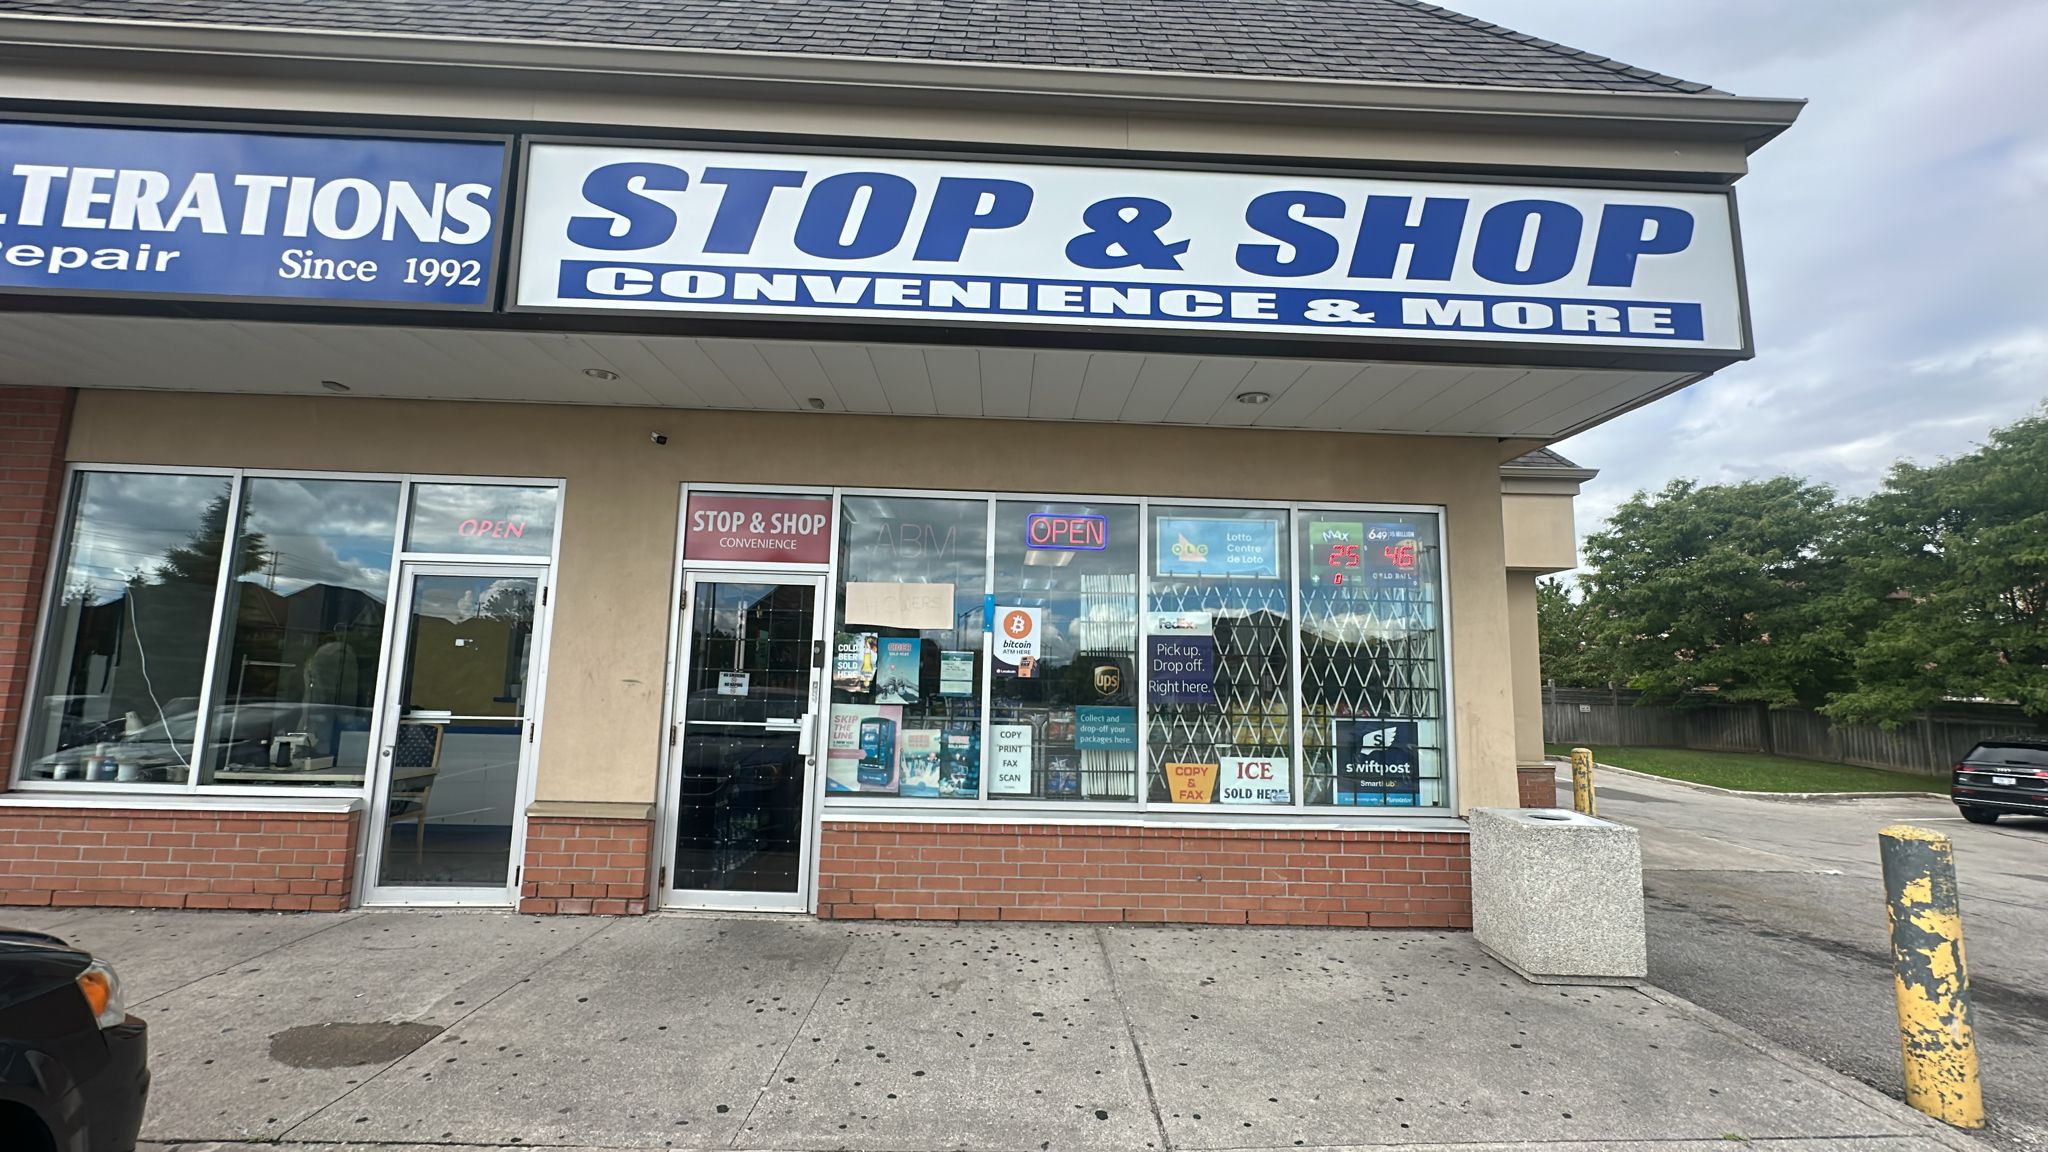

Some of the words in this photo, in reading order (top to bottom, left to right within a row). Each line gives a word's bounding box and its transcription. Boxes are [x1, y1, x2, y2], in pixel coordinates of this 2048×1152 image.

[0, 164, 492, 244] TERATIONS
[566, 161, 1034, 262] STOP
[1065, 196, 1191, 272] &
[1235, 190, 1694, 288] SHOP
[0, 243, 180, 274] epair
[279, 249, 378, 282] Since
[403, 257, 482, 287] 1992
[586, 266, 1279, 321] CONVENIENCE
[1303, 298, 1375, 324] &
[1402, 298, 1676, 335] MORE
[693, 510, 745, 533] STOP
[749, 512, 767, 534] &
[770, 513, 827, 535] SHOP
[458, 518, 527, 538] OPEN
[1031, 518, 1103, 544] OPEN
[873, 522, 956, 560] ABM
[1227, 533, 1252, 541] Lotto
[720, 538, 797, 549] CONVENIENCE
[1227, 544, 1261, 553] Centre
[1227, 555, 1240, 563] de
[1243, 555, 1264, 563] Loto
[1329, 544, 1359, 567] 25
[1384, 545, 1415, 567] 46
[838, 644, 858, 652] COLD
[1003, 640, 1032, 648] bitcoin
[1157, 643, 1181, 656] Pick
[1183, 646, 1201, 659] up.
[838, 653, 858, 661] BEER
[838, 662, 858, 670] SOLD
[1153, 659, 1183, 675] Drop
[1185, 659, 1205, 672] off.
[838, 671, 858, 679] HERE
[1096, 675, 1118, 691] ups
[1148, 680, 1180, 696] Right
[1182, 680, 1211, 693] here.
[834, 715, 859, 724] SKIP
[1080, 714, 1105, 722] Collect
[1106, 715, 1120, 723] and
[834, 723, 852, 731] THE
[1080, 725, 1109, 734] drop-off
[1110, 726, 1126, 734] your
[833, 731, 853, 739] LINE
[1000, 731, 1022, 739] COPY
[1080, 735, 1113, 744] packages
[1114, 736, 1133, 744] here.
[998, 745, 1023, 753] PRINT
[1175, 766, 1208, 776] COPY
[1236, 762, 1274, 780] ICE
[999, 774, 1021, 782] SCAN
[1187, 778, 1196, 788] &
[1179, 790, 1204, 800] FAX
[1224, 788, 1253, 799] SOLD
